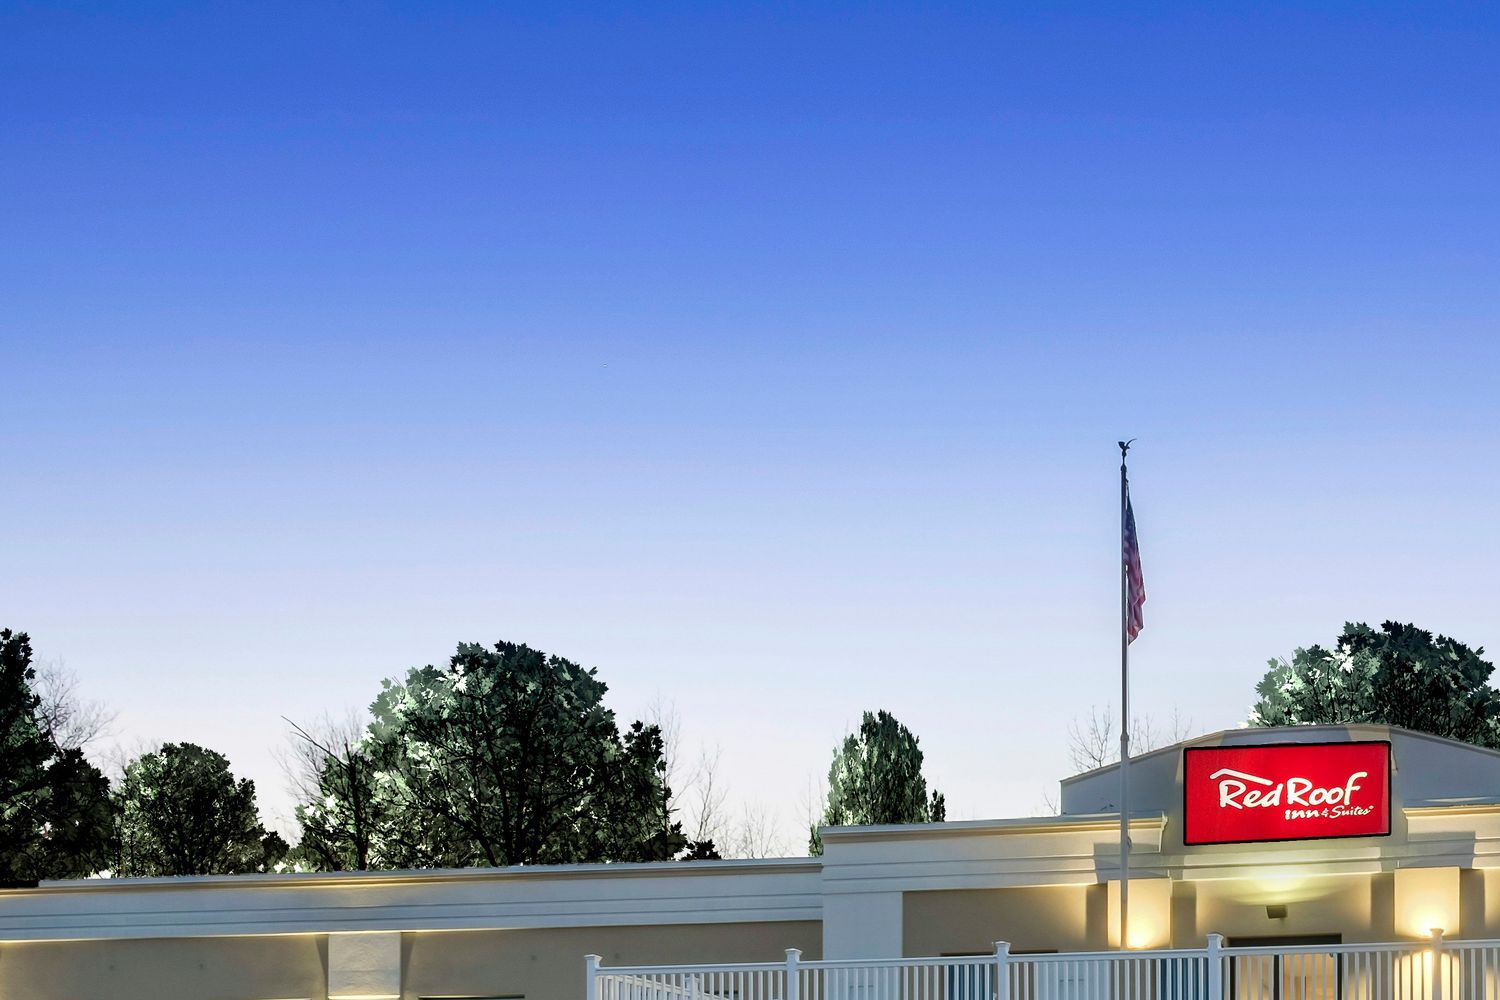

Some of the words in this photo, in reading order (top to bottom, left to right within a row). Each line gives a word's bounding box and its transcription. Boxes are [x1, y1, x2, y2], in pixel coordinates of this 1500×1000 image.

[1219, 779, 1284, 809] Red
[1287, 771, 1368, 807] Roof
[1321, 808, 1329, 818] &
